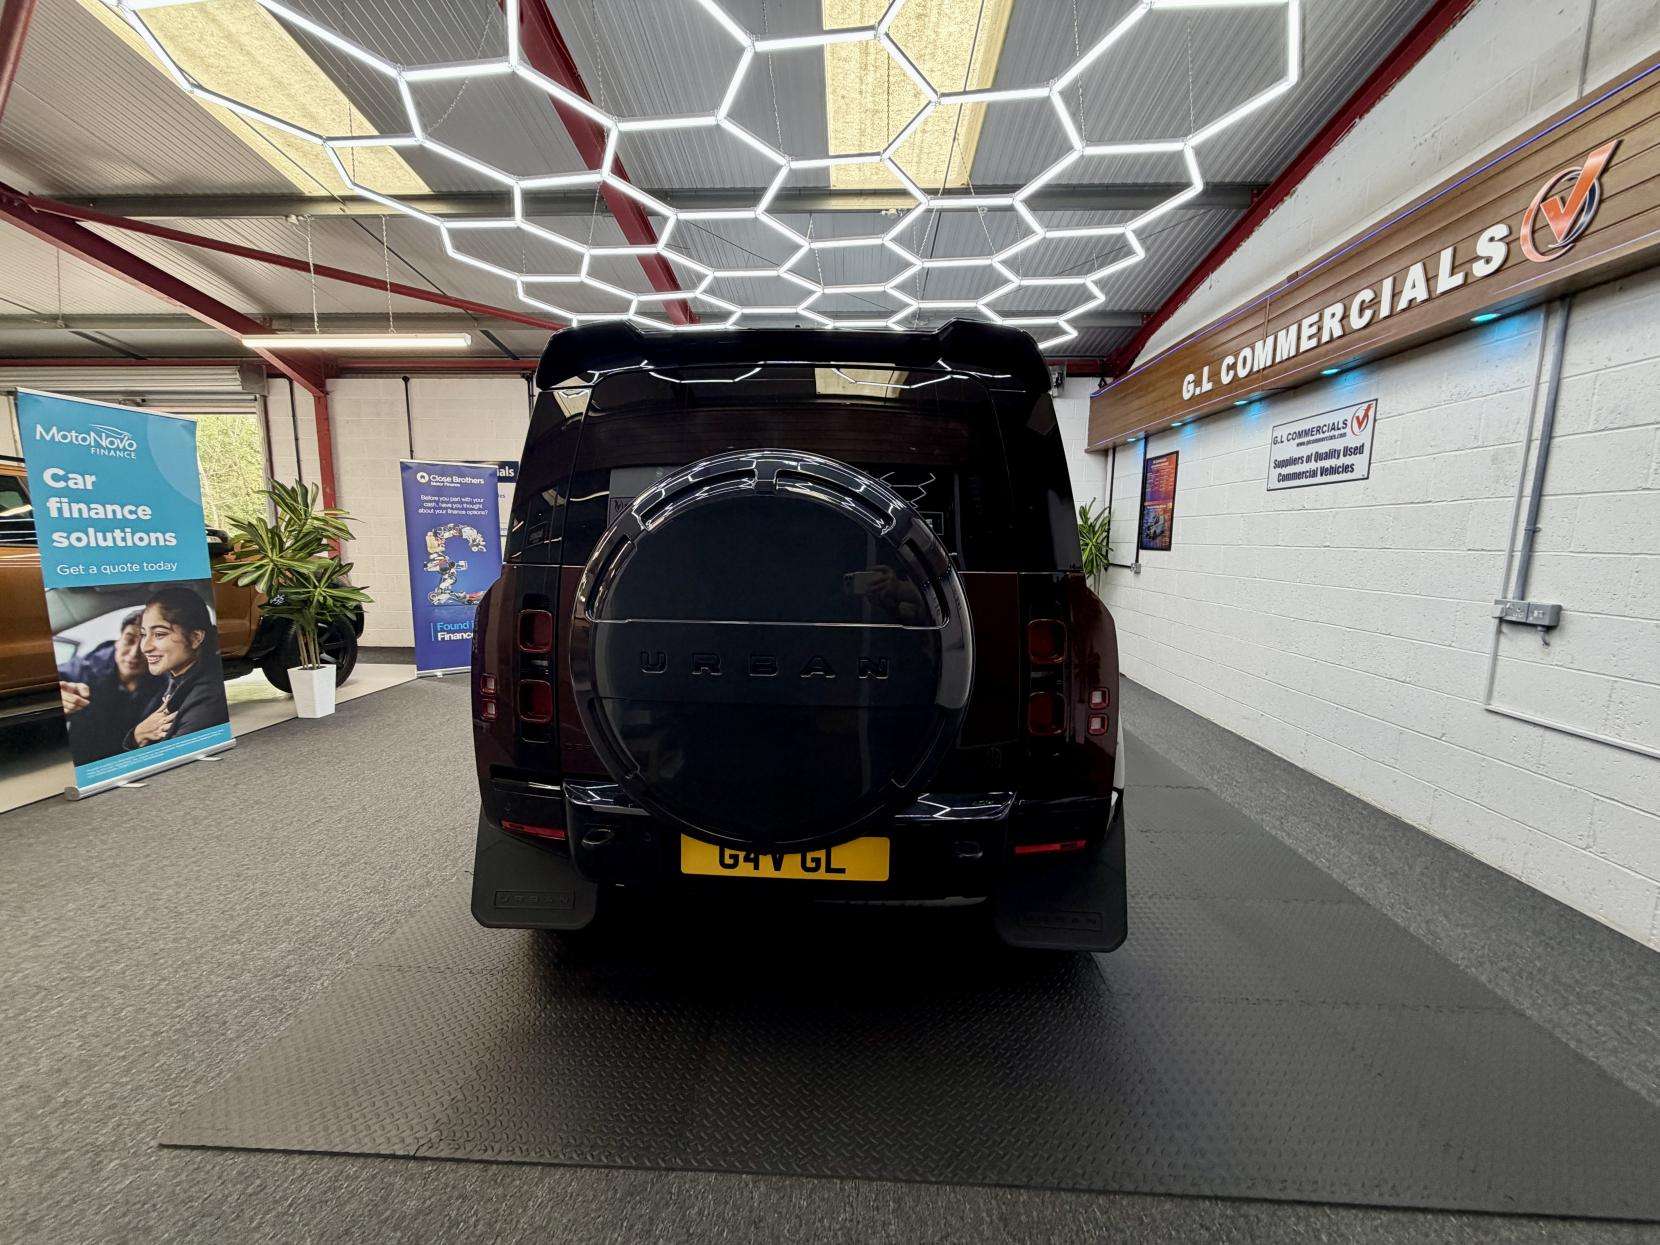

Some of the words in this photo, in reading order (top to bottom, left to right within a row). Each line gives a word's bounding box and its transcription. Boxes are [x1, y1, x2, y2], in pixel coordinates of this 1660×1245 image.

[1182, 365, 1214, 400] G.L
[1220, 223, 1511, 385] COMMERCIALS
[35, 424, 137, 451] MotoNovo
[1273, 434, 1284, 445] G.L
[1286, 419, 1348, 442] COMMERCIALS
[91, 447, 137, 459] FINANCE
[1273, 454, 1304, 469] Suppliers
[1305, 451, 1313, 463] of
[1314, 447, 1341, 462] Quality
[1342, 443, 1365, 457] Used
[43, 467, 96, 490] Car
[452, 476, 485, 484] Brothers
[1277, 467, 1318, 483] Commercial
[1320, 462, 1355, 477] Vehicles
[47, 497, 152, 520] finance
[52, 528, 177, 547] solutions
[57, 564, 85, 575] Get
[89, 566, 97, 574] a
[101, 562, 140, 575] quote
[143, 561, 177, 572] today
[437, 621, 470, 630] Found
[437, 632, 474, 641] Financ
[640, 651, 889, 679] URBAN
